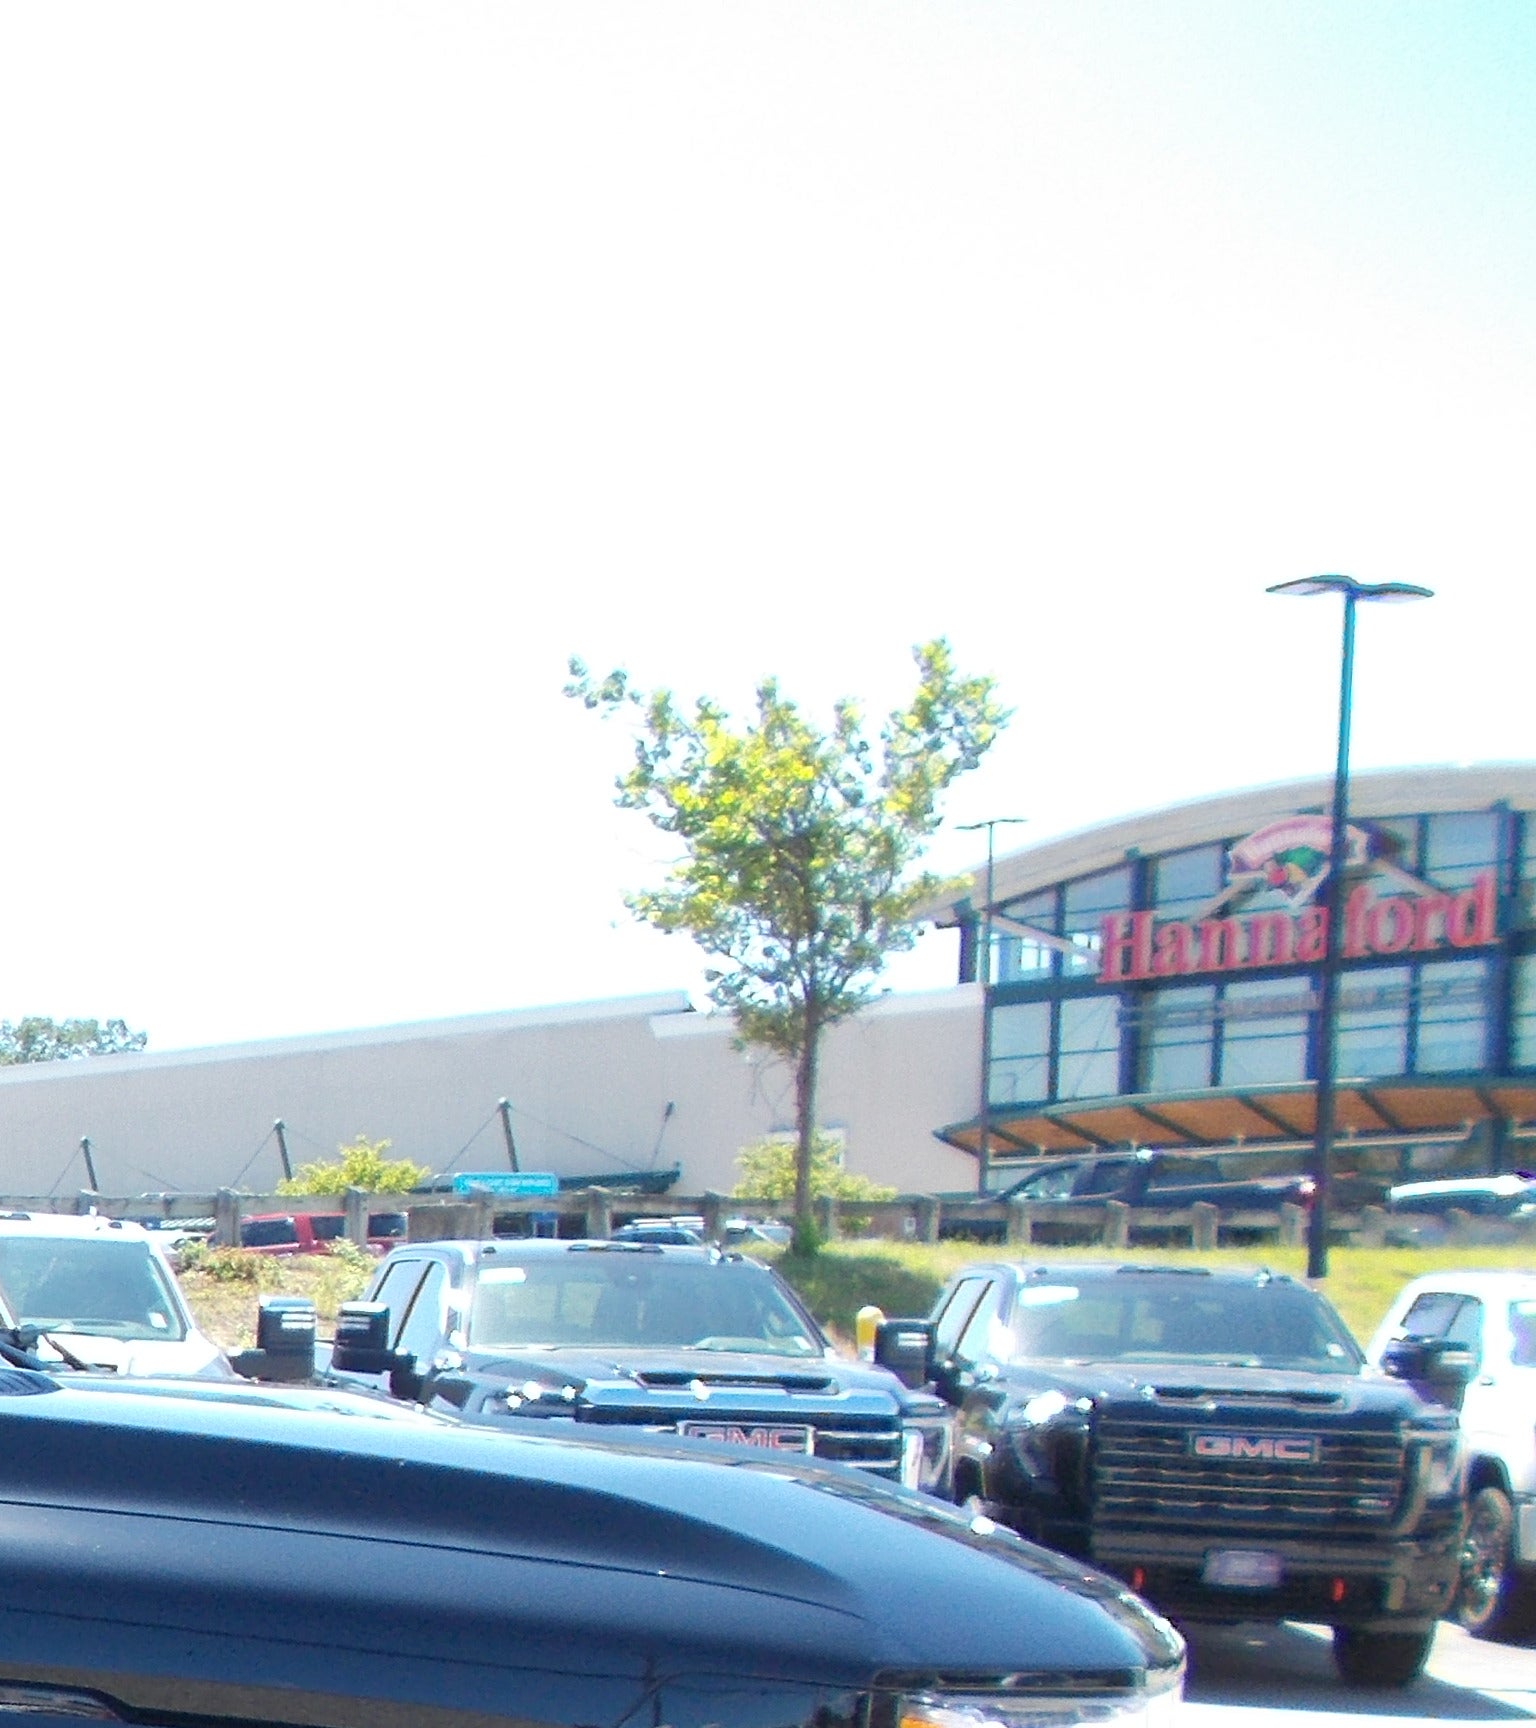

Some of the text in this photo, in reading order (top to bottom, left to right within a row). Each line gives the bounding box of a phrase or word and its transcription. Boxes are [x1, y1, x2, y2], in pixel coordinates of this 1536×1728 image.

[1095, 870, 1502, 983] Hannaford
[689, 1426, 805, 1451] GMC
[1195, 1436, 1311, 1460] GMC
